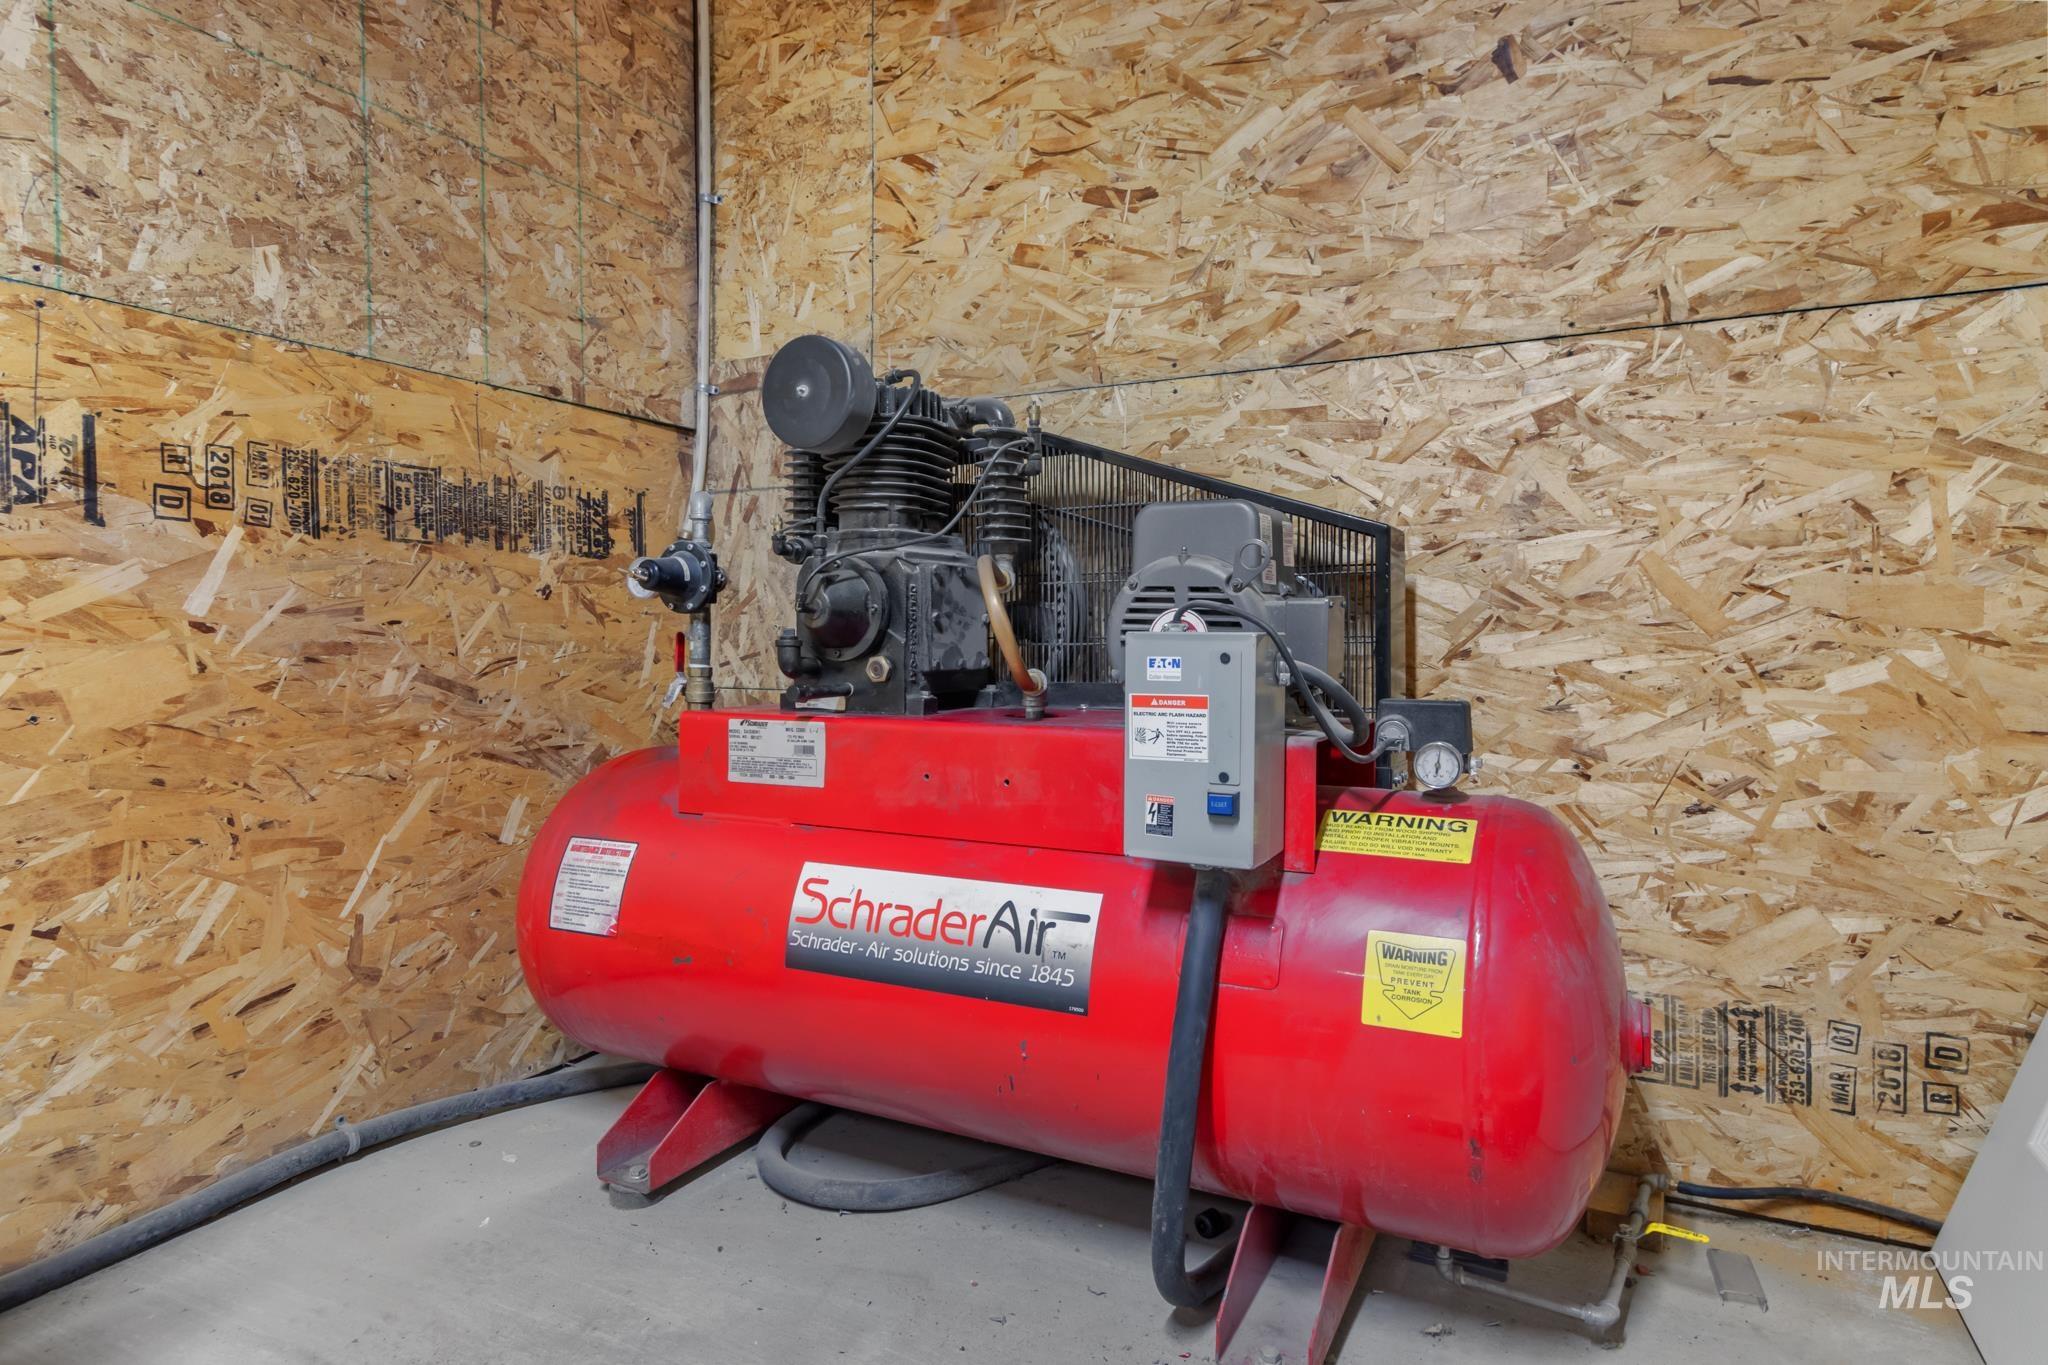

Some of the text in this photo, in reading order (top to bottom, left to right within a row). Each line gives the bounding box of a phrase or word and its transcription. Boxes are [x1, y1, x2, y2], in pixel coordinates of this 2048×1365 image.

[11, 414, 38, 505] APA
[167, 454, 187, 465] R
[209, 451, 231, 504] 2018
[301, 465, 310, 499] PRODUCT
[159, 494, 184, 509] D
[250, 503, 269, 521] 01
[1148, 658, 1181, 669] EATON
[1158, 699, 1186, 707] DANGER
[1331, 811, 1469, 833] WARNING
[1372, 831, 1421, 840] INSTALLATION
[1391, 838, 1427, 846] VIBRATION
[1415, 846, 1453, 854] WARRANTY
[794, 877, 1067, 961] SchraderAir TM
[1382, 943, 1448, 967] WARNING
[892, 947, 970, 972] solutions
[974, 956, 1022, 981] since
[1028, 964, 1076, 988] 1845
[1401, 964, 1428, 972] MOISTURE
[1390, 976, 1434, 989] PREVENT
[1391, 994, 1433, 1005] CORROSION
[1403, 988, 1422, 996] TANK
[1700, 1008, 1717, 1085] THIS SIDE DOWN
[1934, 1046, 1962, 1061] D
[1678, 1056, 1694, 1081] MADE
[1748, 1065, 1758, 1082] THIS
[1828, 1027, 1855, 1105] MAR 01
[1877, 1049, 1902, 1106] 2018
[1930, 1093, 1953, 1105] R
